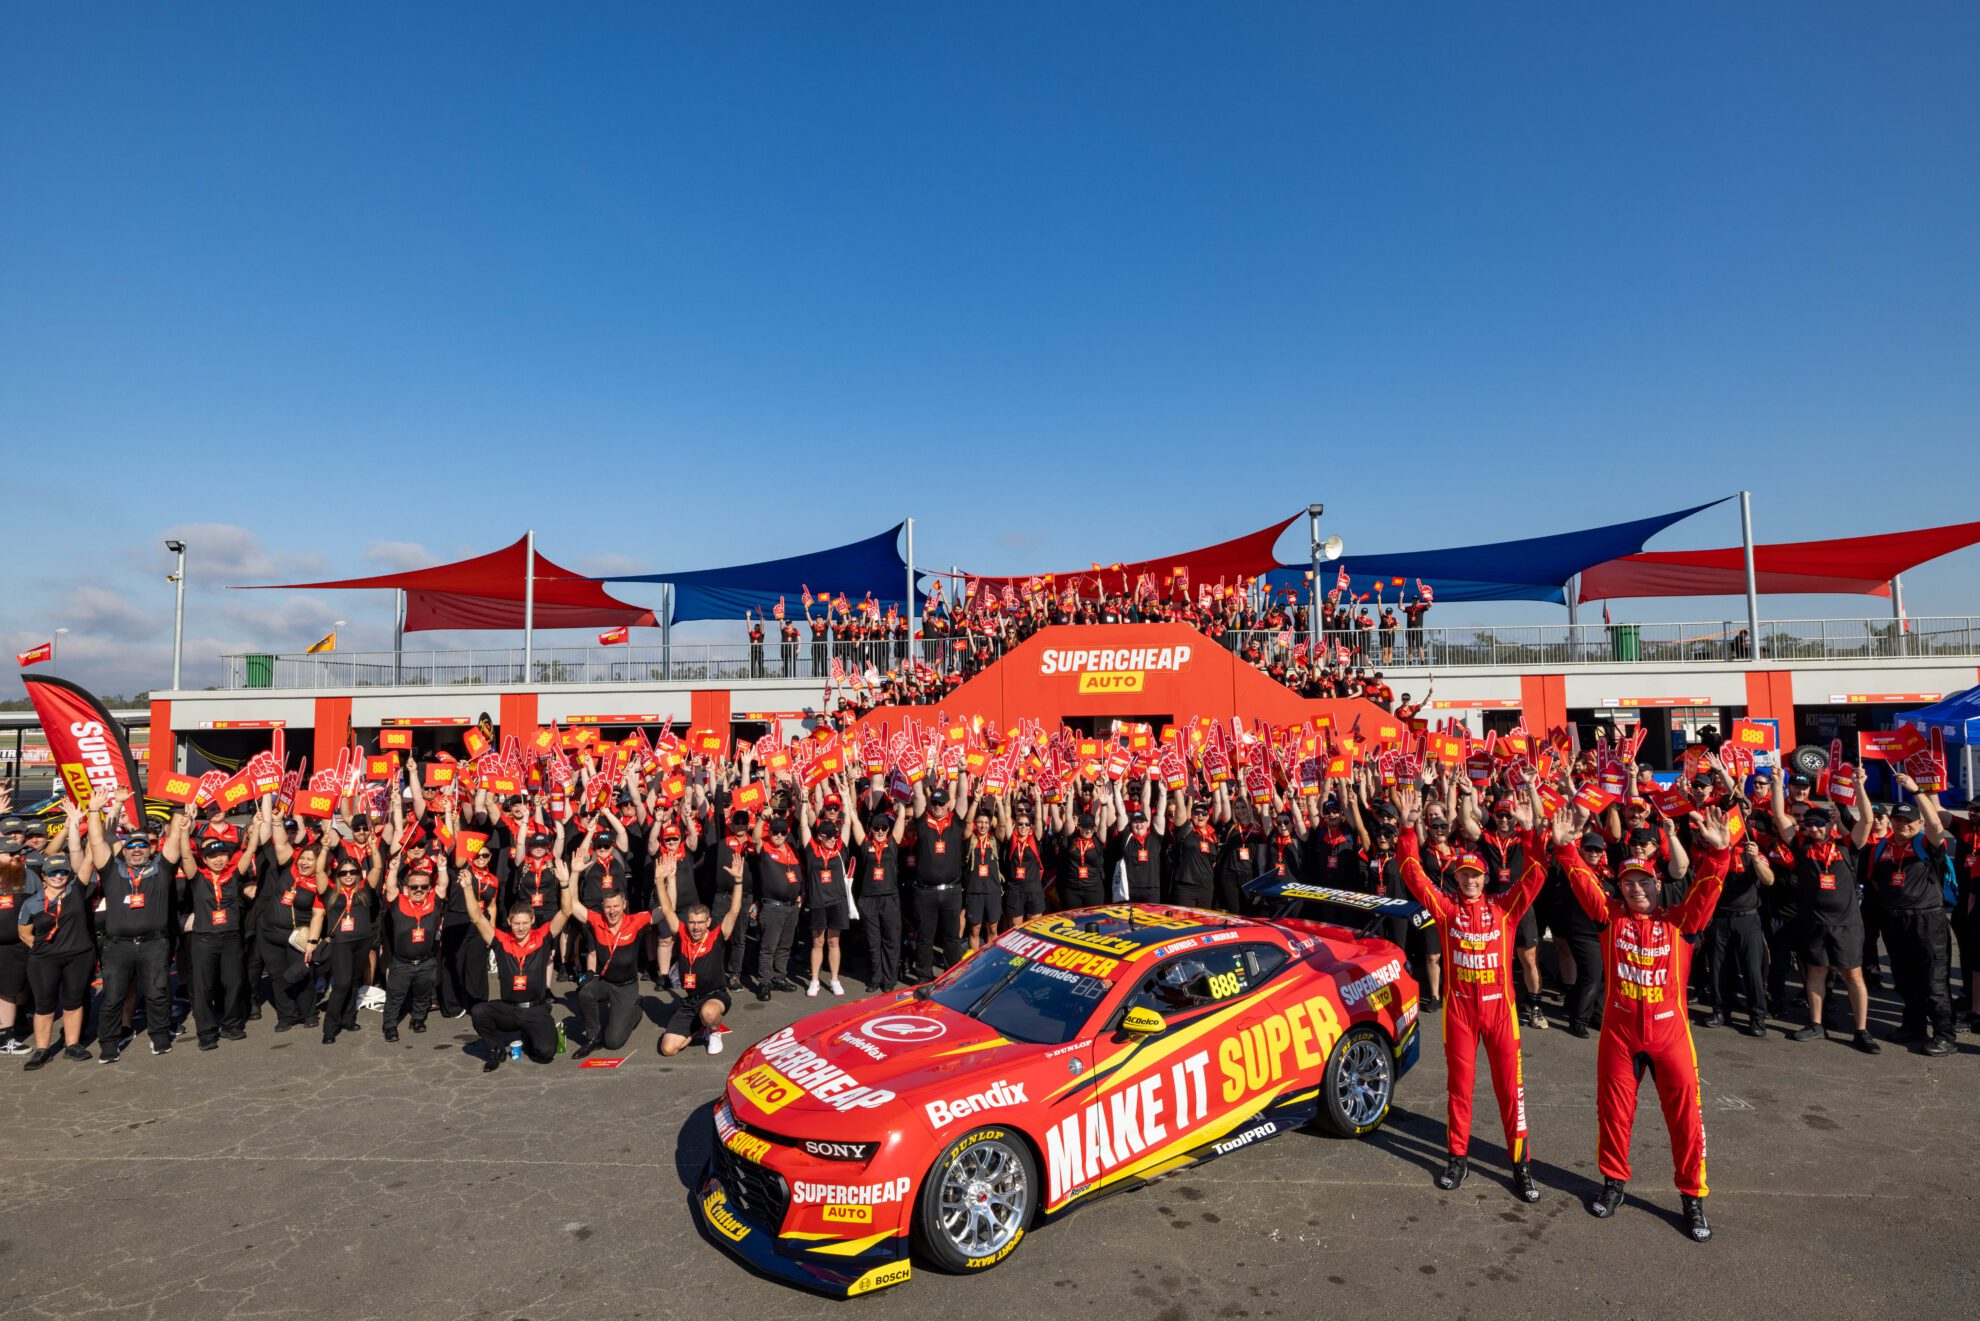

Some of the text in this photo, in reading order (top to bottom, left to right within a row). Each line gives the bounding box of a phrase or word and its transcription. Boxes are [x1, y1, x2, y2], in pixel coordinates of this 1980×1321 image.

[1041, 646, 1190, 674] SUPERCHEAP
[1086, 676, 1136, 688] AUTO
[387, 734, 405, 744] 888
[1381, 727, 1396, 737] 888
[1742, 728, 1764, 744] 888
[703, 738, 720, 749] 888
[1081, 744, 1097, 755] 888
[1445, 743, 1458, 756] 888
[372, 762, 387, 773] 888
[434, 769, 452, 780] 888
[166, 780, 191, 796] 888
[256, 775, 280, 786] MAKE IT
[259, 783, 279, 792] SUPER
[496, 780, 514, 791] 888
[224, 784, 248, 802] 888
[740, 789, 758, 802] 888
[310, 797, 331, 811] 888
[1281, 882, 1408, 907] SUPERCHEAP
[1049, 917, 1141, 952] Century
[1211, 931, 1239, 942] MURRAY
[1450, 928, 1500, 942] SUPERCHEAP
[996, 930, 1119, 978] MAKE IT SUPER
[1164, 938, 1198, 954] LOWNDES
[1453, 950, 1498, 969] MAKE IT
[1029, 962, 1080, 984] Lowndes
[1457, 967, 1495, 984] SUPER
[1617, 962, 1667, 986] MAKE IT
[1209, 972, 1240, 999] 888
[1340, 959, 1401, 1006] SUPERCHEAP
[1621, 980, 1664, 1003] SUPER
[1125, 1016, 1159, 1025] ACDelco
[1053, 1039, 1093, 1056] DUNLOP
[755, 1027, 896, 1112] SUPERCHEAP
[742, 1071, 787, 1103] AUTO
[925, 1080, 1029, 1129] Bendix
[1045, 995, 1343, 1203] MAKE IT SUPER
[951, 1131, 1004, 1160] DUNLOP
[1211, 1121, 1277, 1155] ToolPRO
[727, 1131, 772, 1164] SUPER
[805, 1141, 866, 1158] SONY
[793, 1177, 910, 1204] SUPERCHEAP
[828, 1207, 866, 1219] AUTO
[966, 1227, 1024, 1267] SPORT MAXX
[875, 1269, 909, 1285] BOSCH
